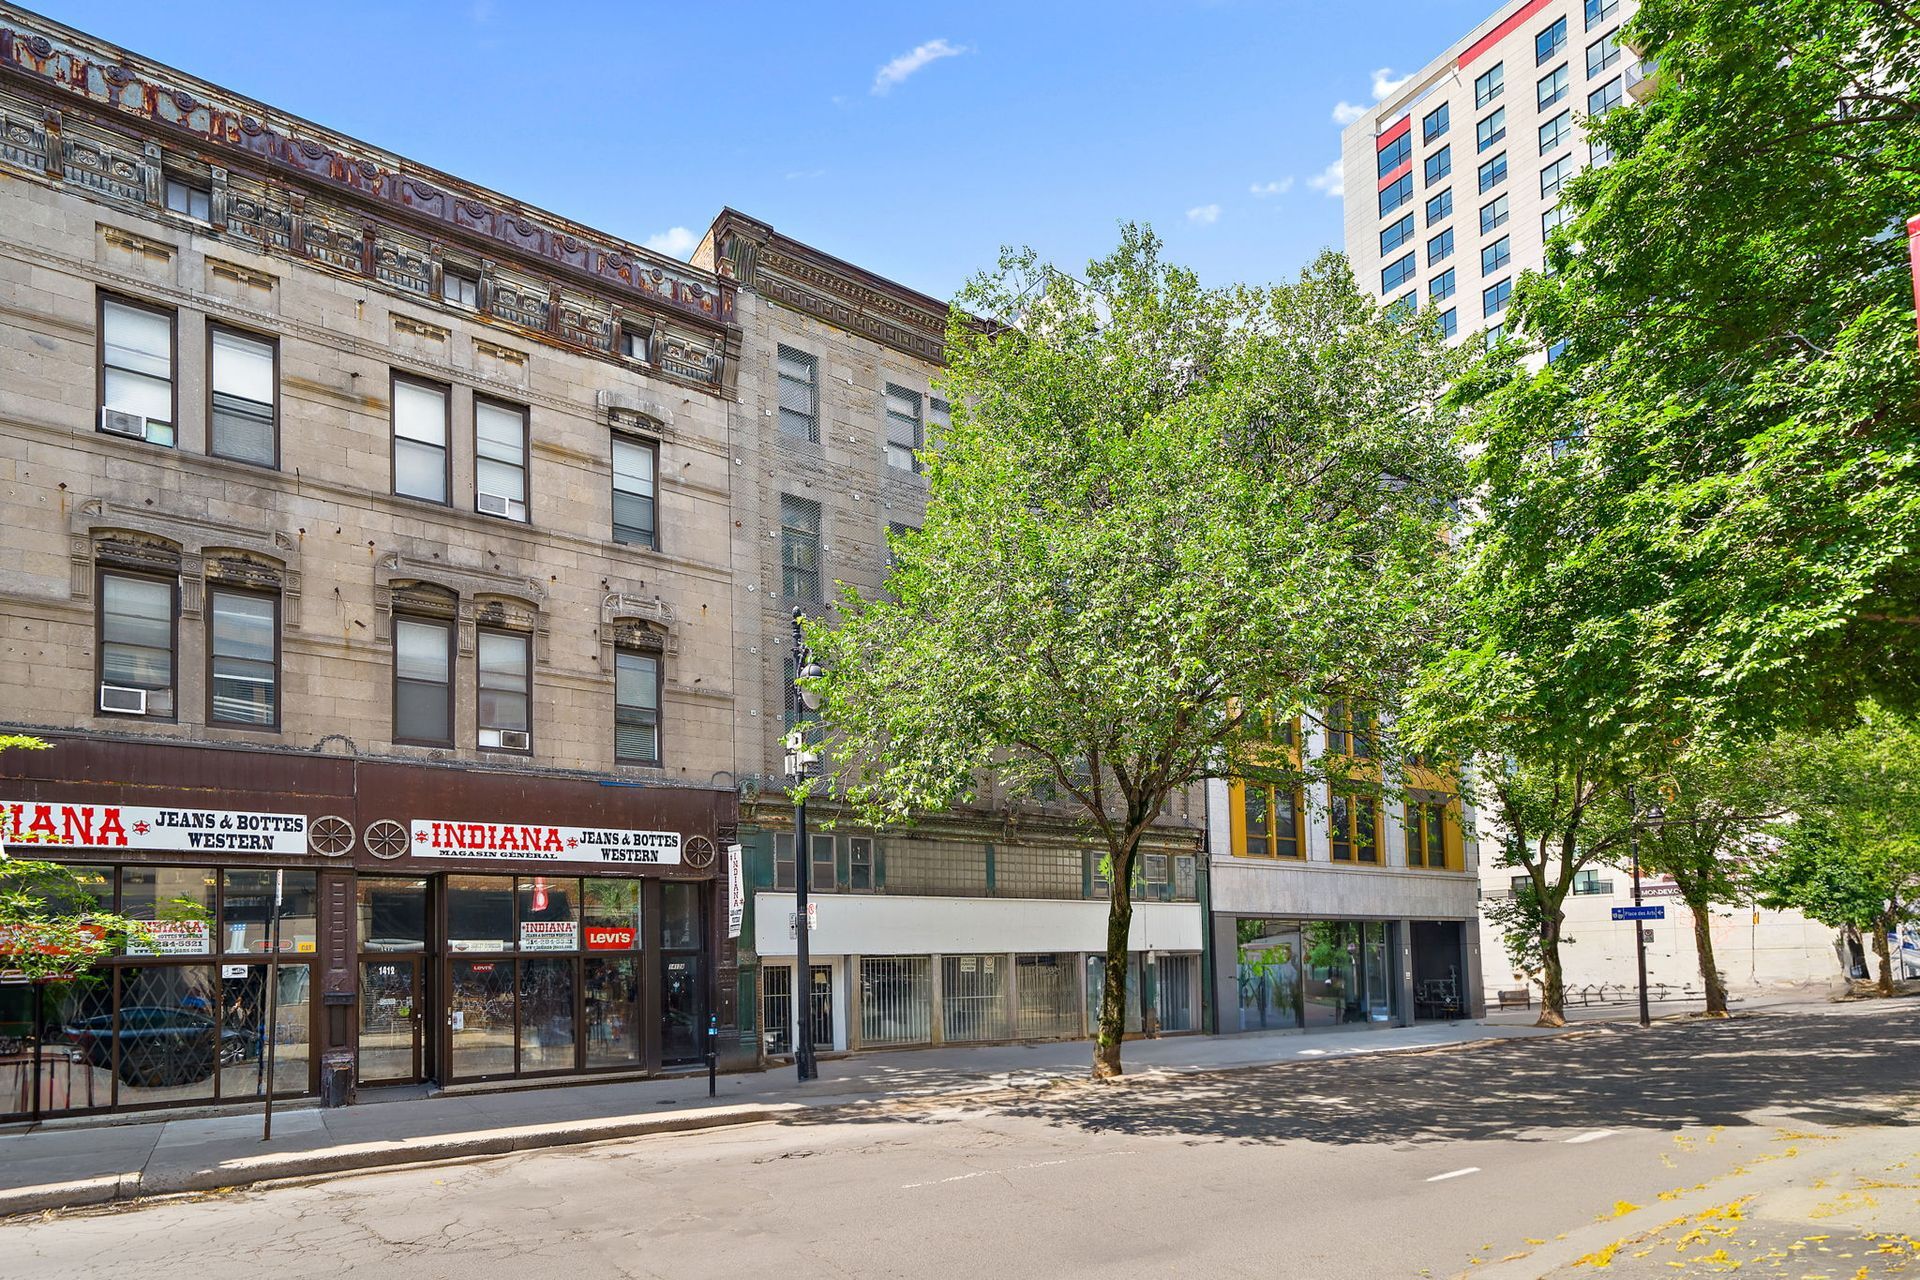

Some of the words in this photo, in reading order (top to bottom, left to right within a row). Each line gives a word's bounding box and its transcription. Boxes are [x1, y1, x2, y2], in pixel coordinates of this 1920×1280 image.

[0, 804, 128, 846] IANA
[155, 811, 215, 829] JEANS
[220, 815, 233, 830] &
[237, 815, 304, 833] BOTTES
[188, 832, 275, 850] WESTERN
[431, 822, 564, 852] INDIANA
[580, 832, 619, 845] JEANS
[622, 833, 631, 846] &
[633, 834, 678, 847] BOTTES
[439, 850, 497, 858] MAGASIN
[500, 851, 558, 860] GÉNÉRAL
[601, 848, 659, 862] WESTERN
[526, 923, 573, 932] INDIANA
[379, 966, 395, 975] 1412
